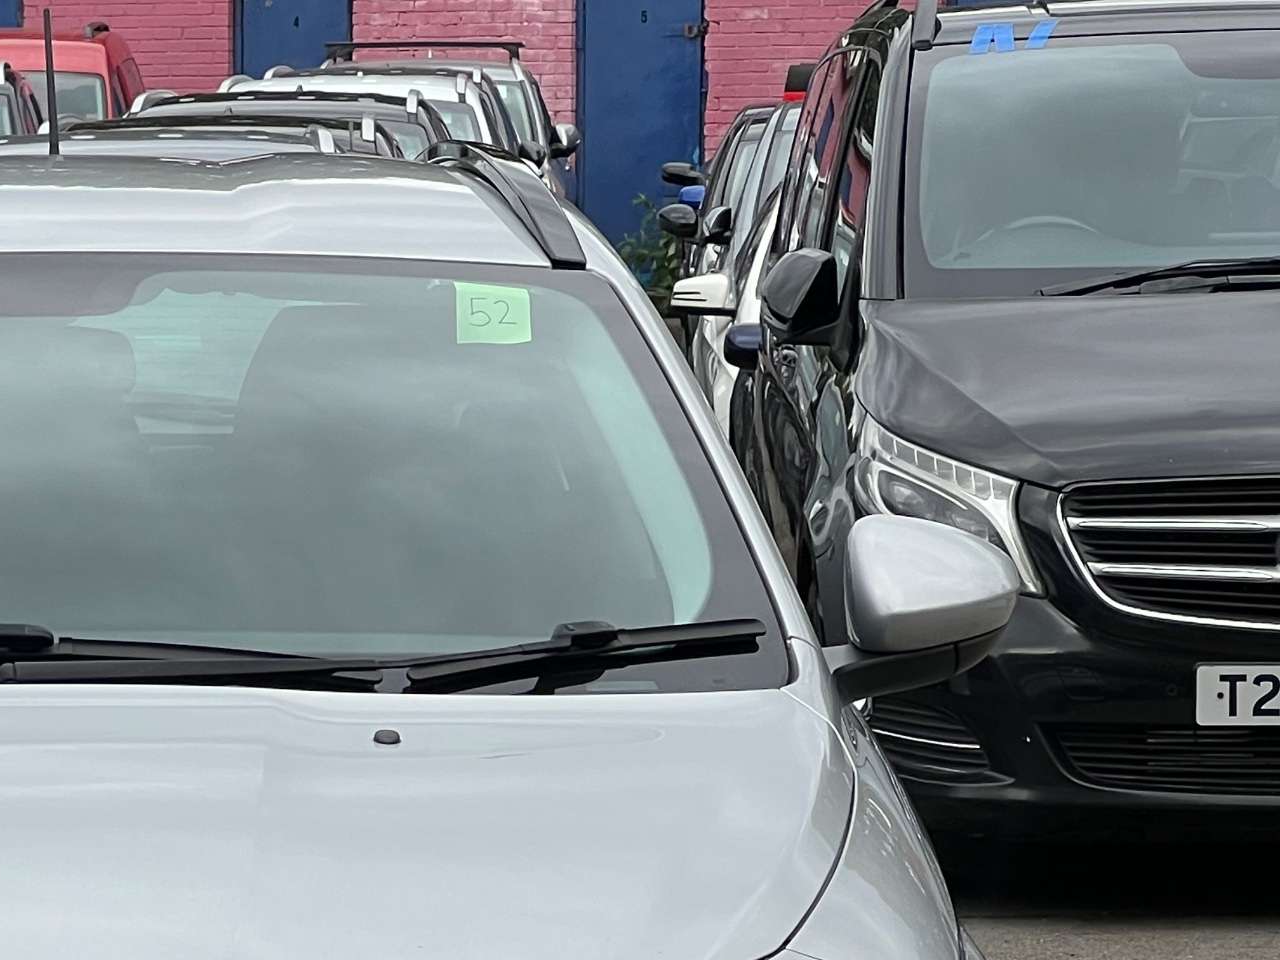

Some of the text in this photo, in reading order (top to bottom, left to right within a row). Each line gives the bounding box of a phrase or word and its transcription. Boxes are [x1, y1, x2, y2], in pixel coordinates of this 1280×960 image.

[293, 15, 299, 29] 4
[640, 10, 648, 23] 5
[469, 297, 518, 327] 52
[1219, 674, 1280, 716] T2
